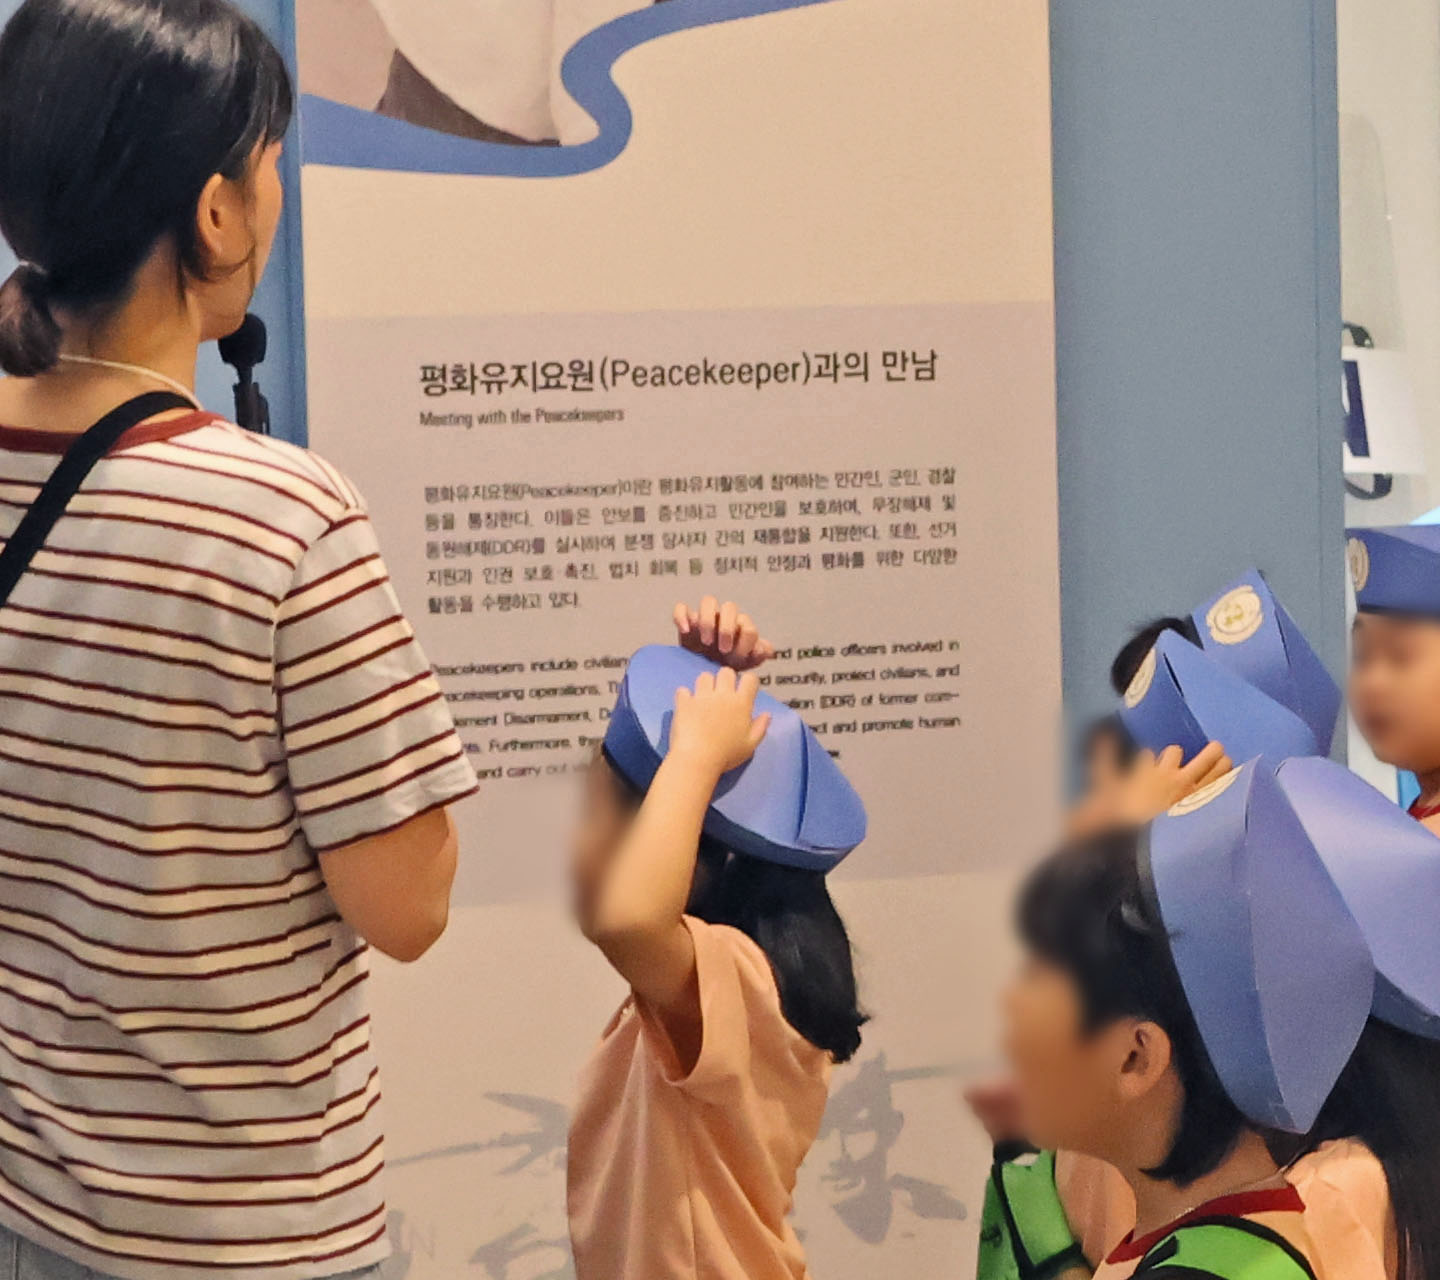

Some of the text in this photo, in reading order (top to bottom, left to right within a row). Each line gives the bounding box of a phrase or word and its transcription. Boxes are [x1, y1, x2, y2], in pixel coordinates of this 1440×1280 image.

[419, 349, 938, 397] 평화유지요원(Peacekeeper)과의 만남
[477, 409, 507, 425] with
[510, 407, 532, 424] the
[584, 655, 629, 669] civilian
